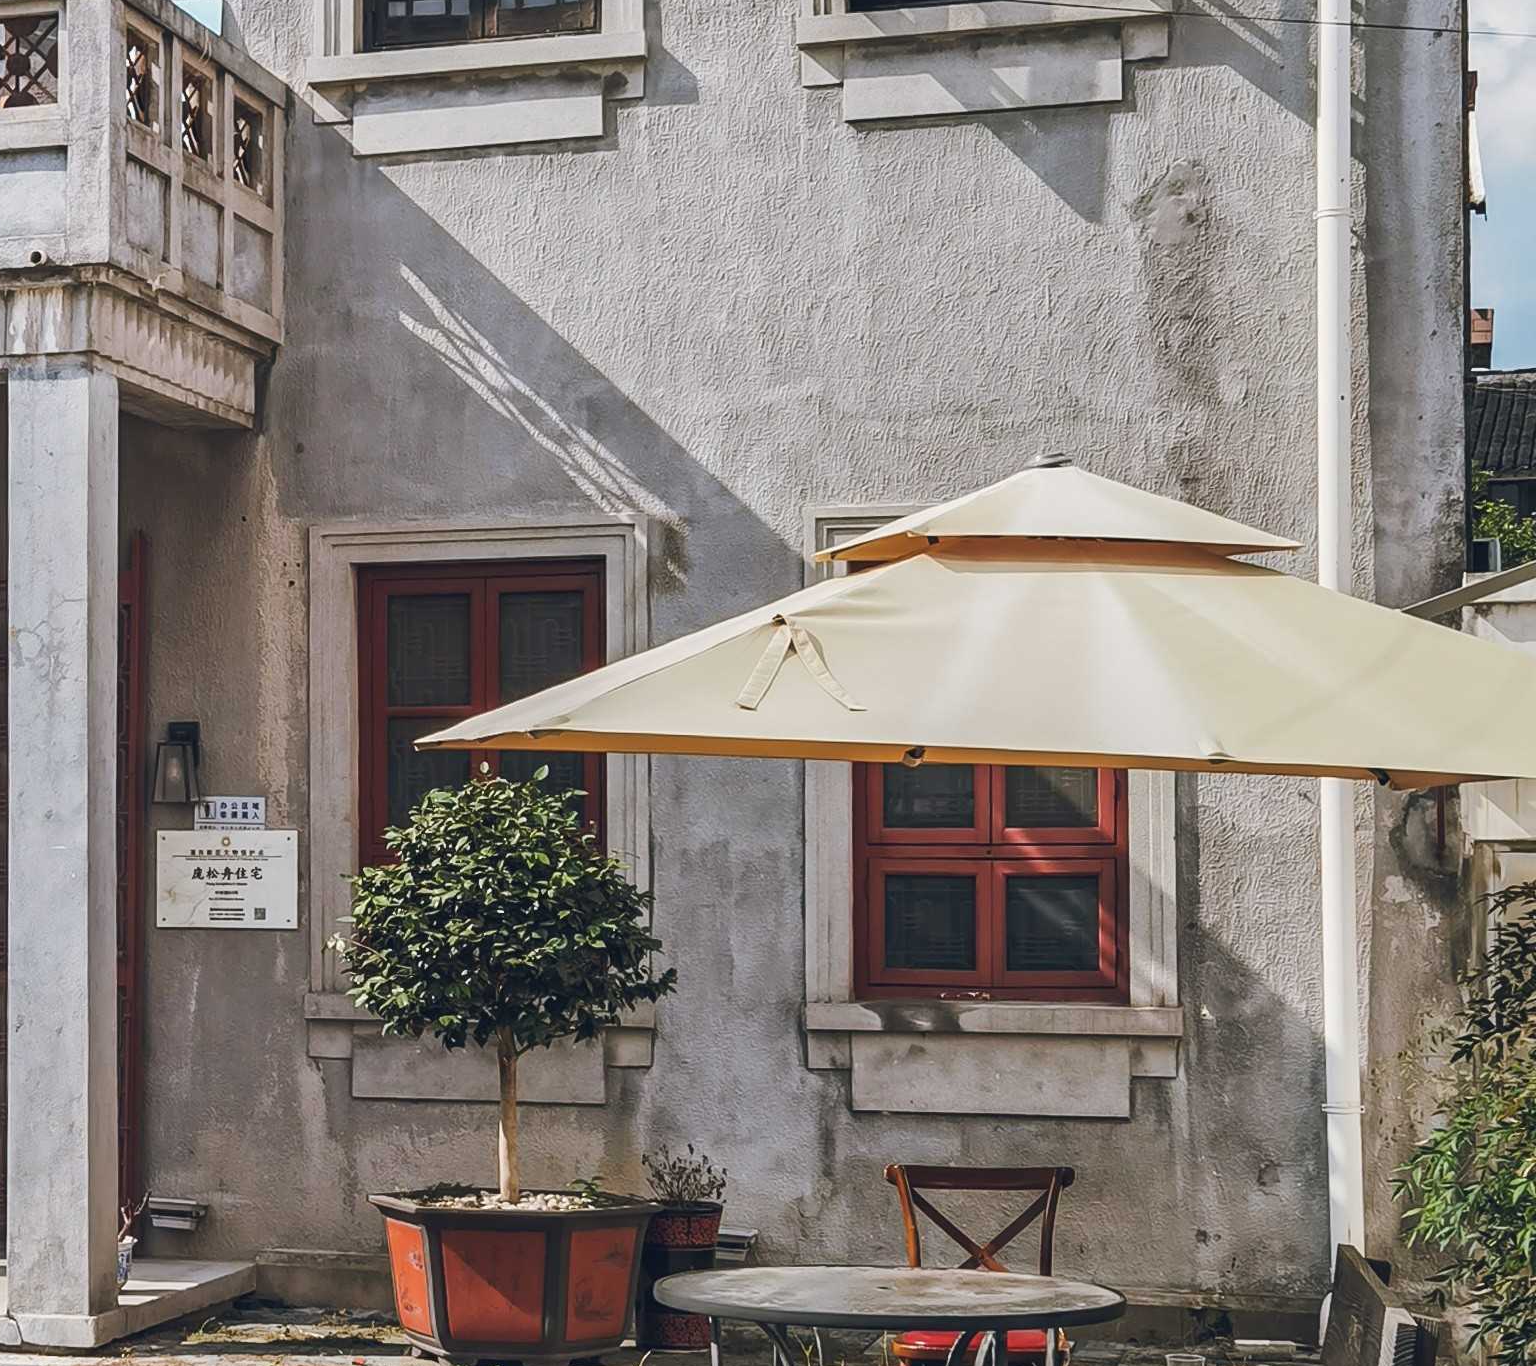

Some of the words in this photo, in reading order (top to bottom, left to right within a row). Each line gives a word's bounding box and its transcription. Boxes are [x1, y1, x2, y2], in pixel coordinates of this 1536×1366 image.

[220, 802, 259, 810] 办公区域
[192, 867, 263, 880] 庞松舟住宅
